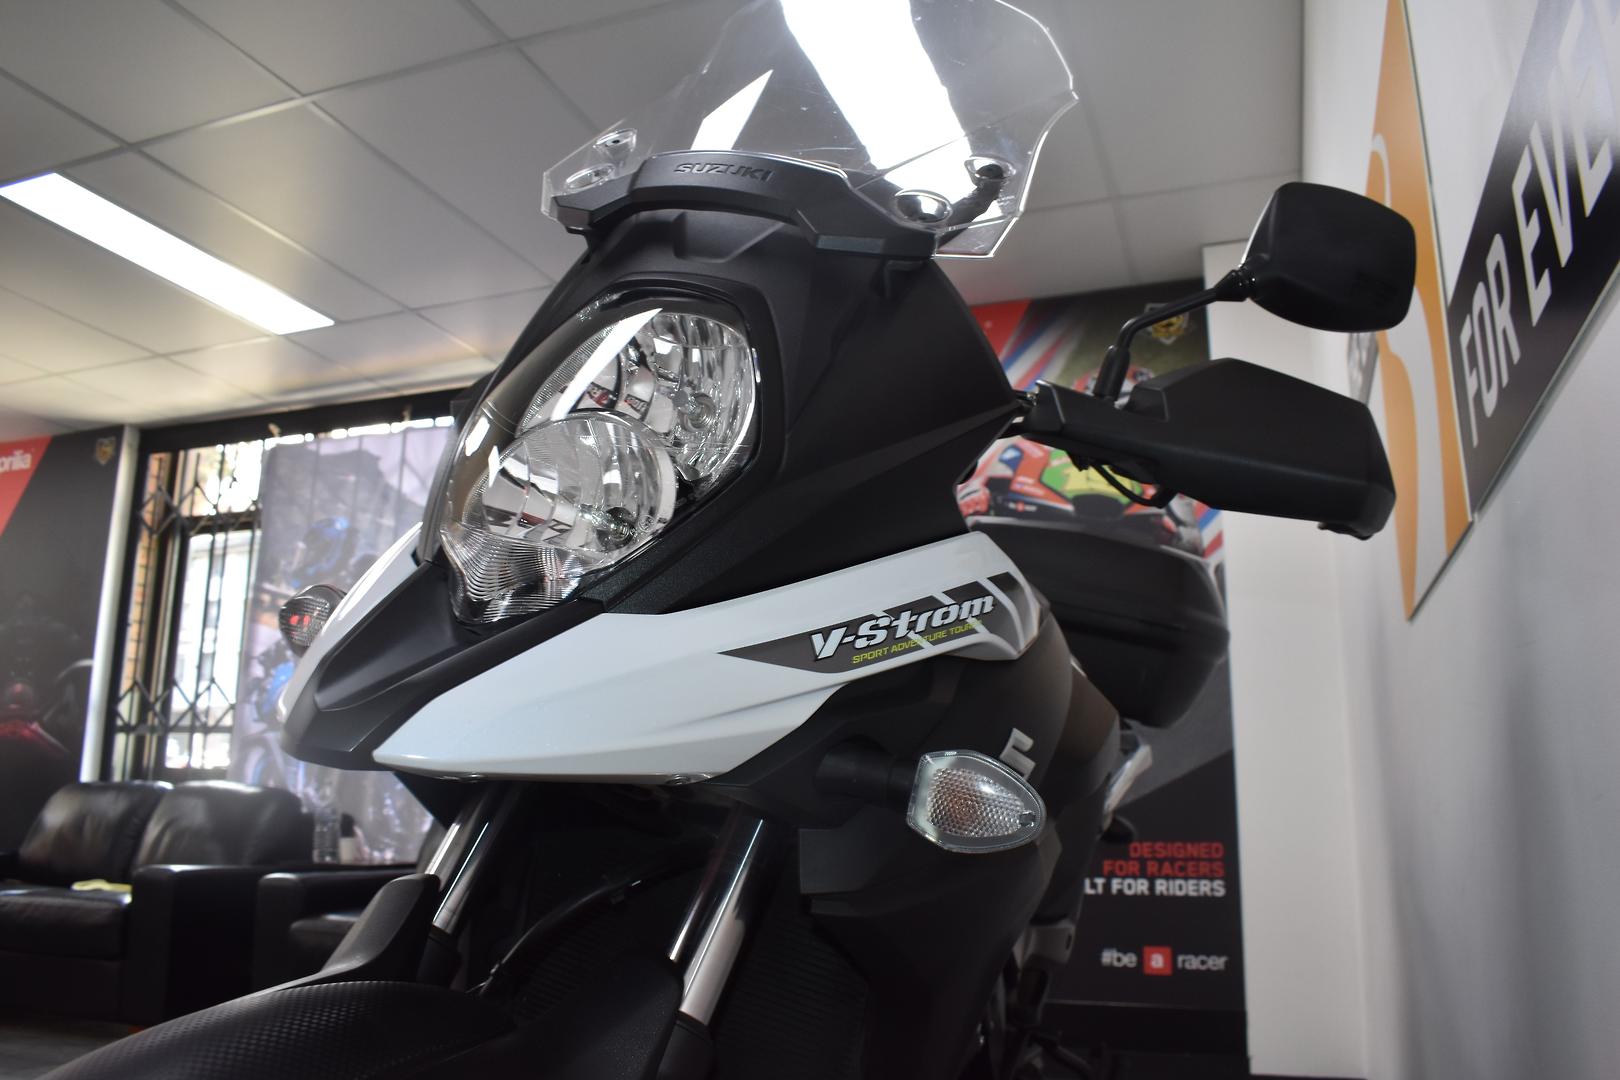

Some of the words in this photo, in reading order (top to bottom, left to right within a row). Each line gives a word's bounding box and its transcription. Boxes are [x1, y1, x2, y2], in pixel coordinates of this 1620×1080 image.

[674, 162, 774, 182] SUZUKI
[1460, 233, 1521, 448] FOR
[811, 594, 995, 659] V-Strom
[852, 647, 889, 664] SPORT
[1129, 842, 1224, 858] DESIGNED
[1103, 860, 1140, 877] FOR
[1147, 860, 1225, 878] RACERS
[1084, 877, 1106, 895] LT
[1111, 878, 1149, 896] FOR
[1155, 879, 1226, 897] RIDERS
[1101, 948, 1138, 968] #be
[1150, 952, 1164, 969] a
[1177, 954, 1228, 970] racer
